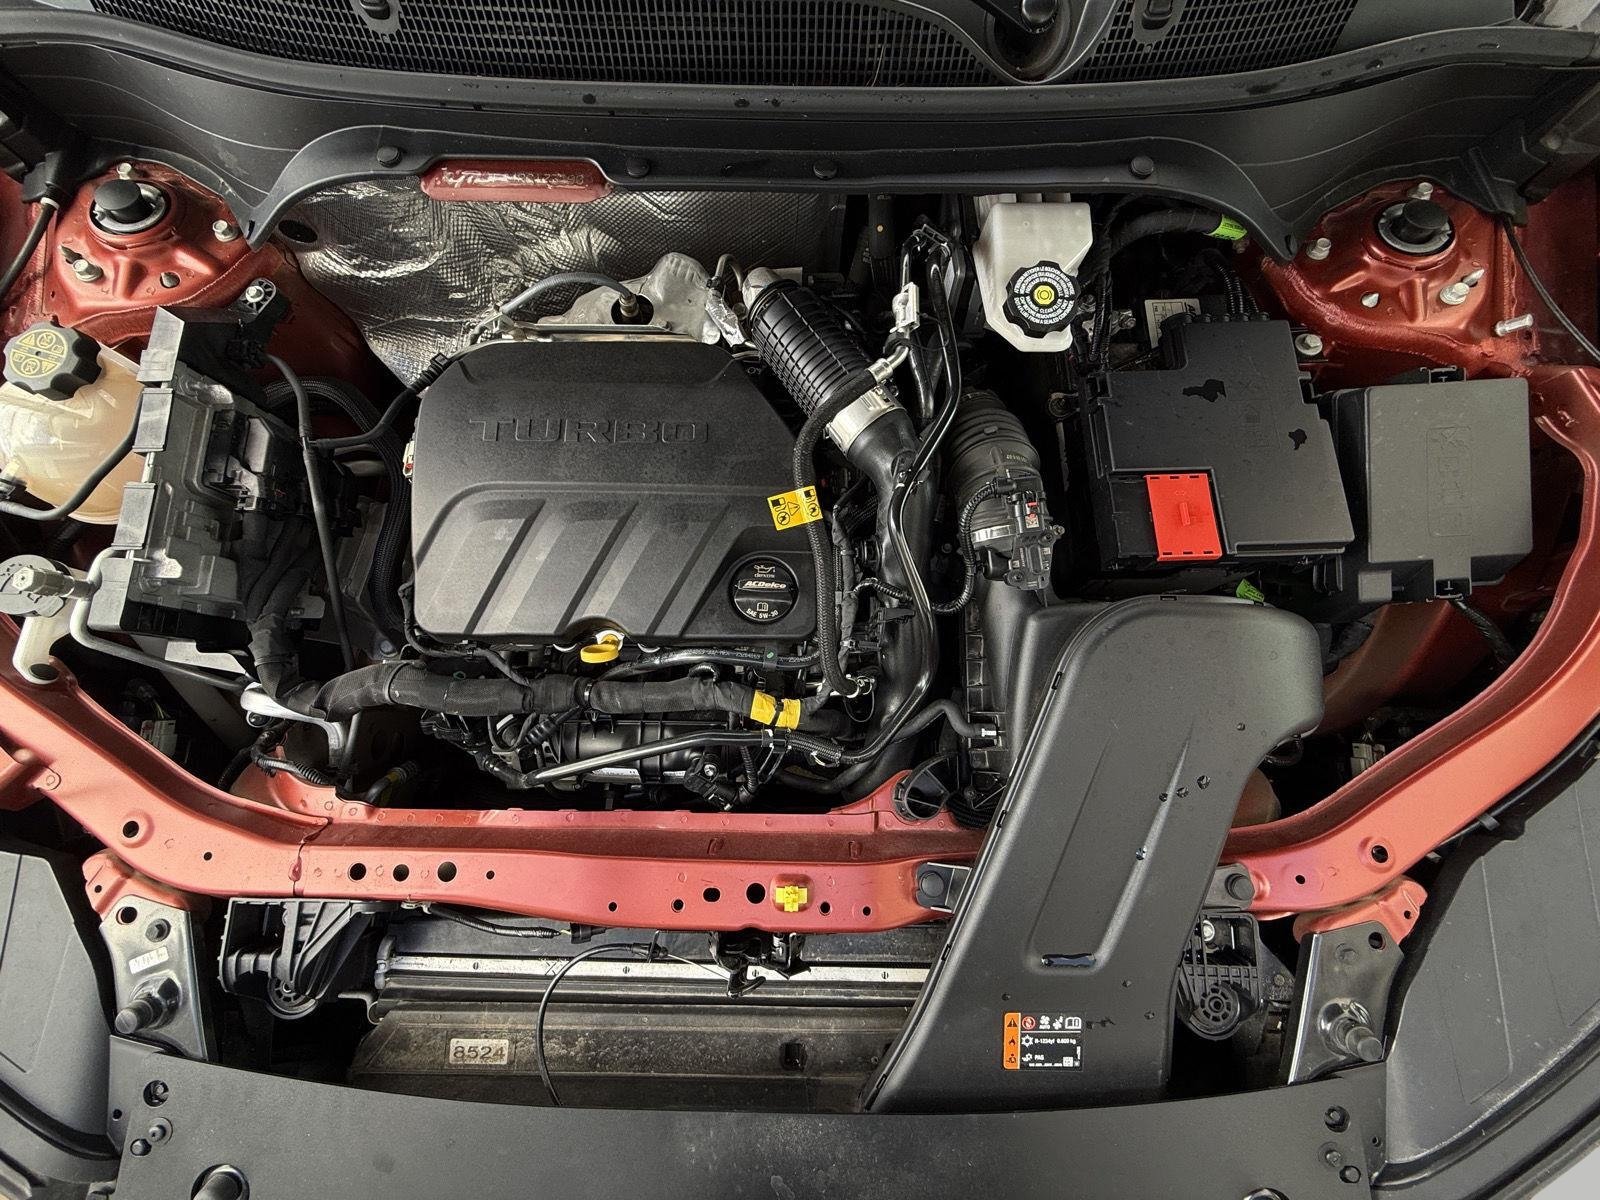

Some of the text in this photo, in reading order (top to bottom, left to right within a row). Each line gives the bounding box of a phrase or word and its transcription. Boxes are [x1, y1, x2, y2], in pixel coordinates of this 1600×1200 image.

[469, 418, 709, 444] TURBO
[744, 581, 787, 589] ACDelco
[746, 608, 779, 619] SAE 5W-30
[453, 1046, 506, 1060] 8524
